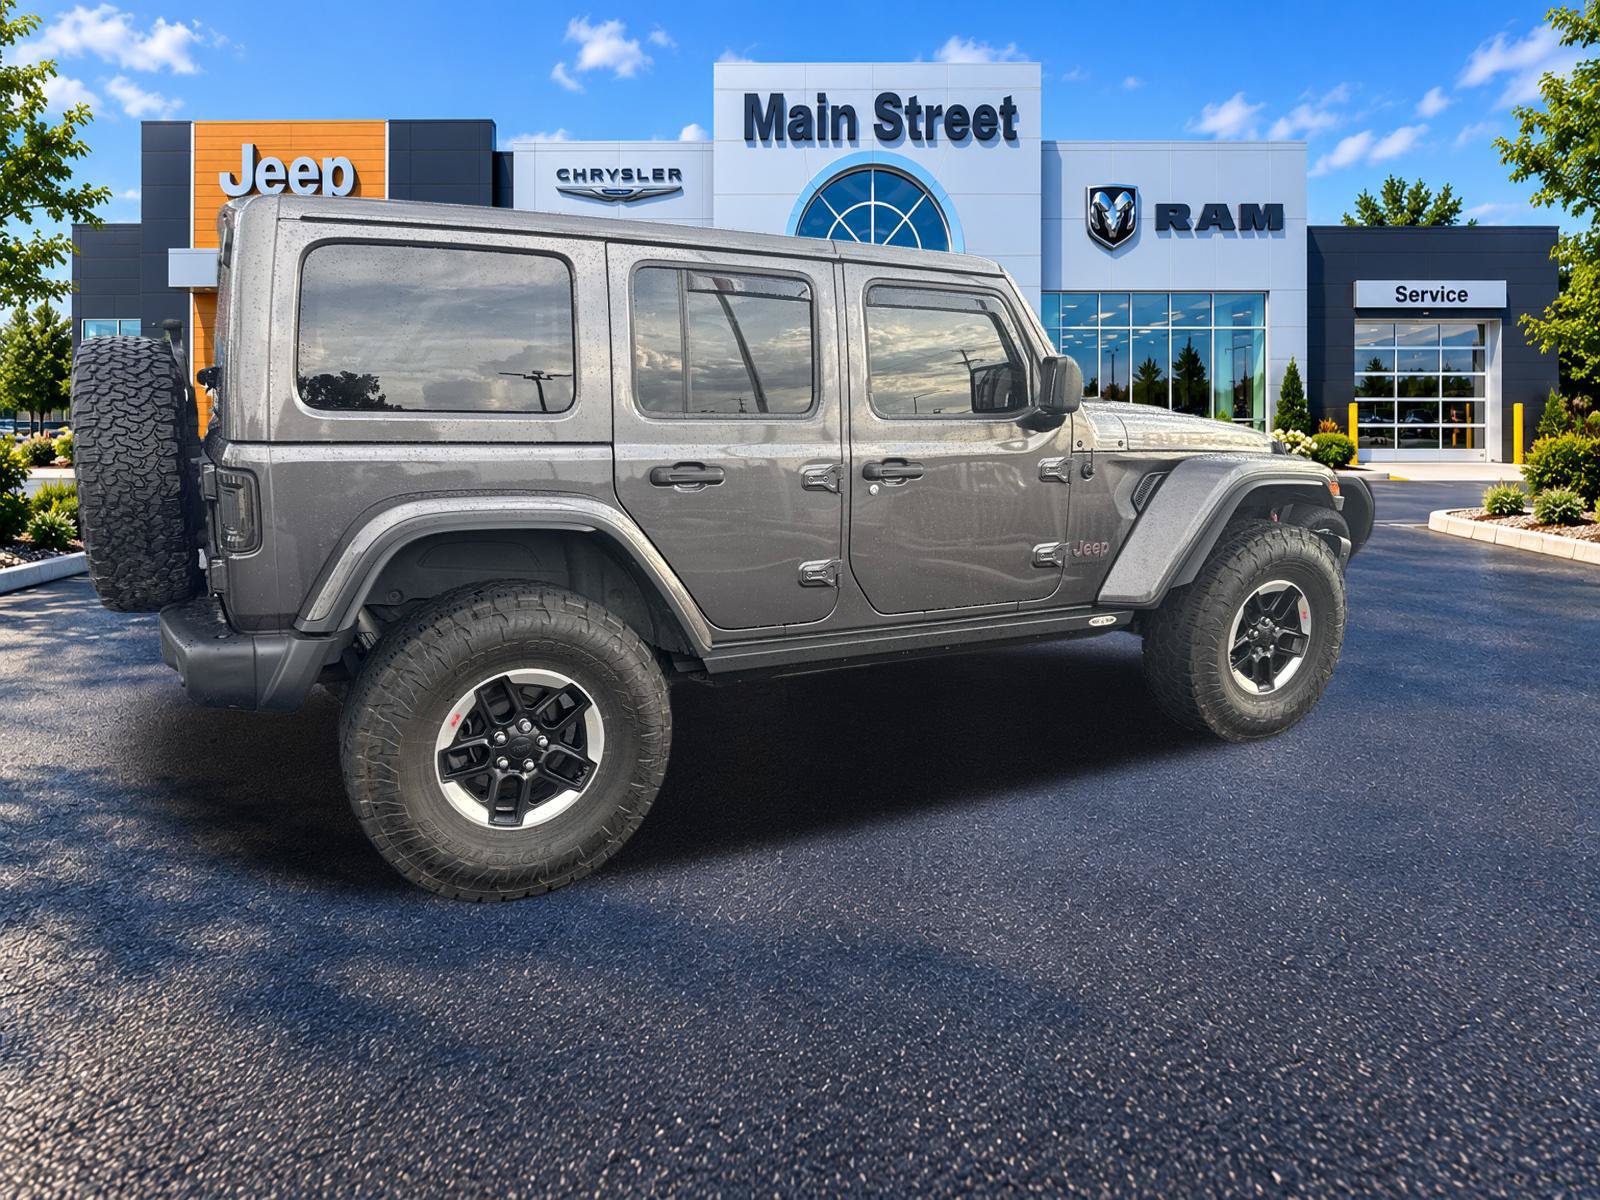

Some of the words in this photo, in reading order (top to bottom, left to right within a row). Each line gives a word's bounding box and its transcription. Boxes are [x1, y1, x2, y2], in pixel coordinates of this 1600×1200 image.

[743, 92, 857, 142] Main
[873, 91, 1017, 142] Street
[218, 143, 355, 197] Jeep
[556, 168, 682, 182] CHRYSLER
[1155, 203, 1284, 231] RAM
[1395, 286, 1469, 302] Service
[1072, 540, 1110, 559] Jeep
